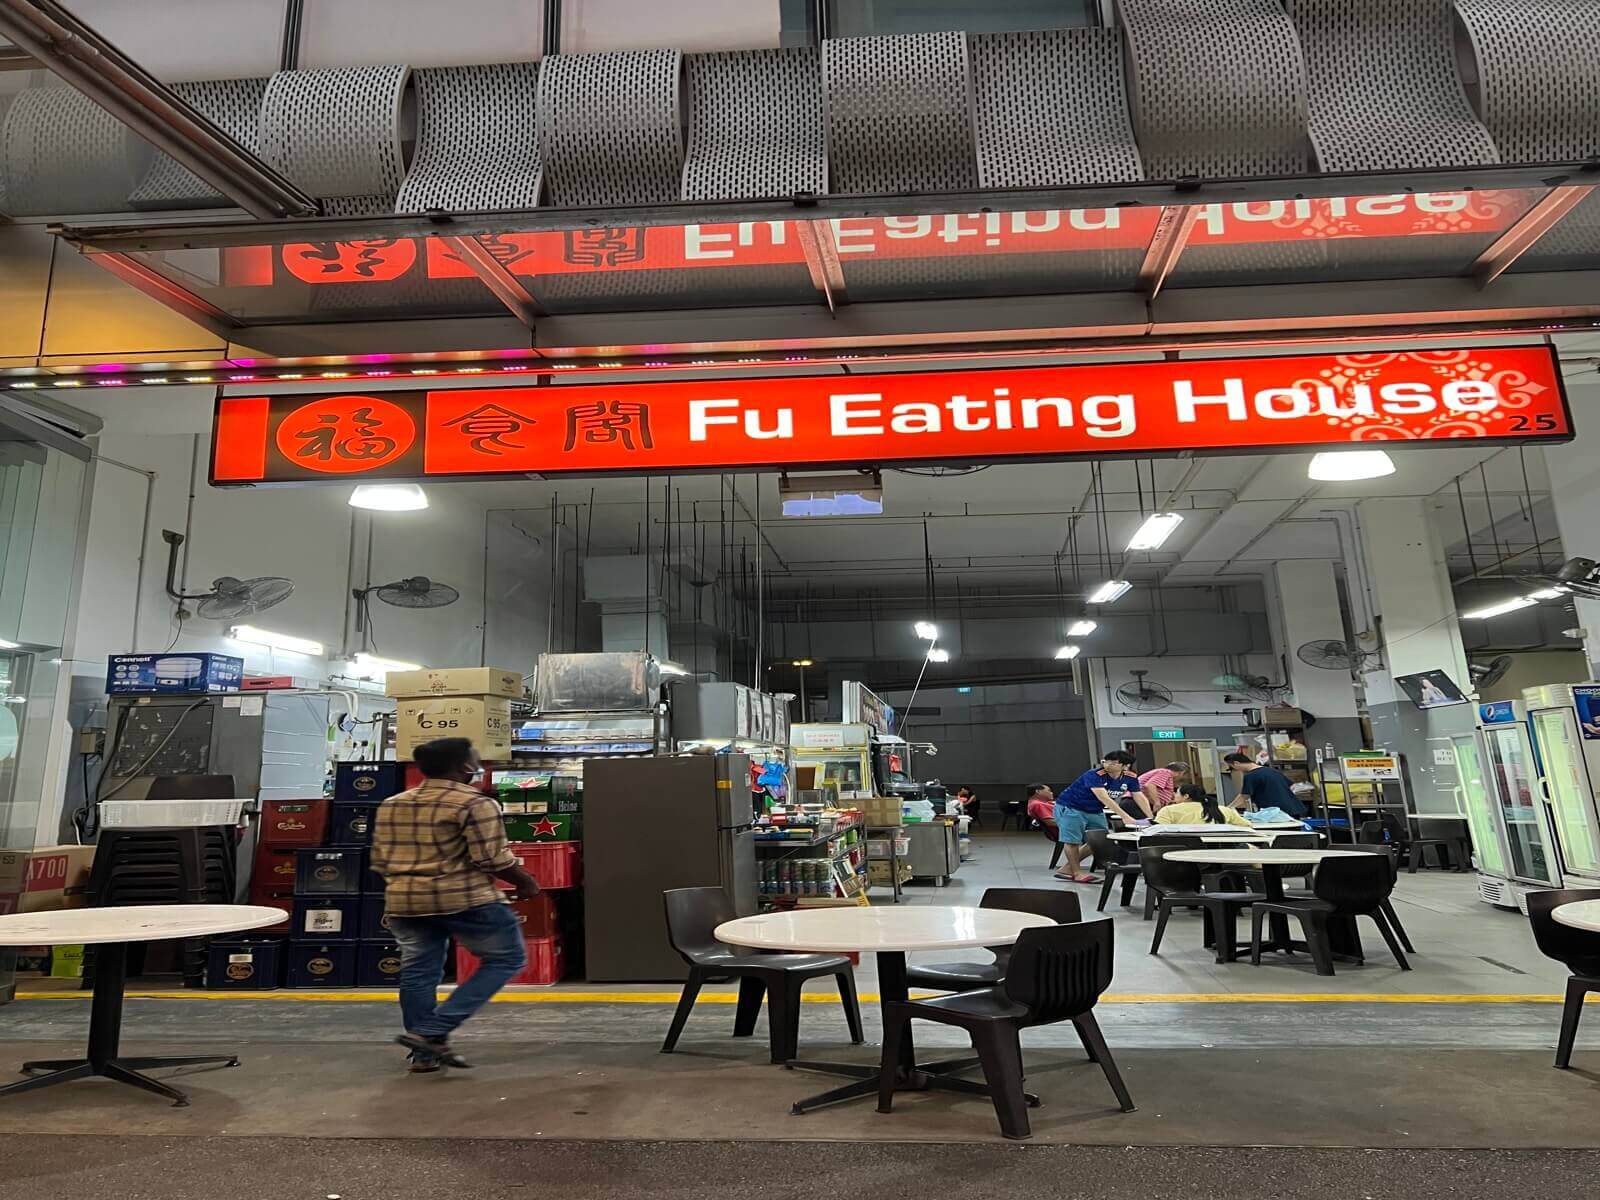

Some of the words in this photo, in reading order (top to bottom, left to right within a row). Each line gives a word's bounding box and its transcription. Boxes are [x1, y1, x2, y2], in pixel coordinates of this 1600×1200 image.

[688, 398, 794, 441] Fu
[829, 387, 1137, 438] Eating
[1172, 377, 1499, 423] House
[1508, 413, 1558, 431] 25
[295, 407, 396, 461] 福
[420, 720, 433, 729] C
[437, 719, 459, 729] 95
[487, 718, 493, 728] C
